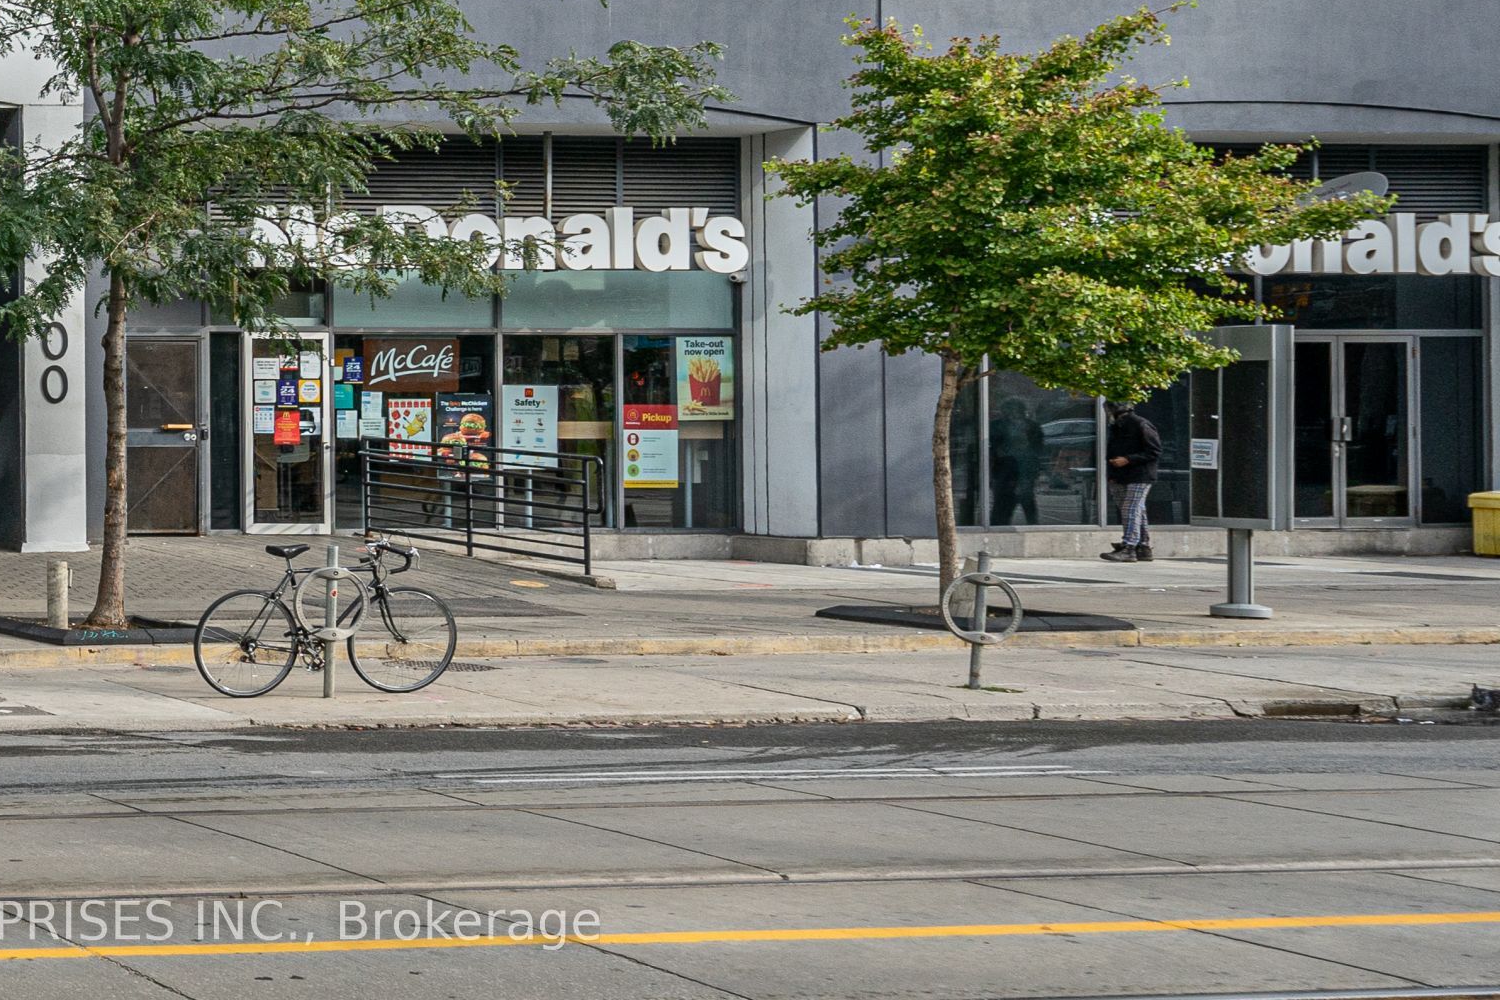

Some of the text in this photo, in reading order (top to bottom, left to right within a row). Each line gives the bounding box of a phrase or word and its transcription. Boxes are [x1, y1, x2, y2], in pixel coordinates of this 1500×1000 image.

[684, 340, 724, 348] Take-out
[703, 349, 725, 357] open
[369, 344, 454, 385] McCafé
[642, 413, 672, 423] Pickup
